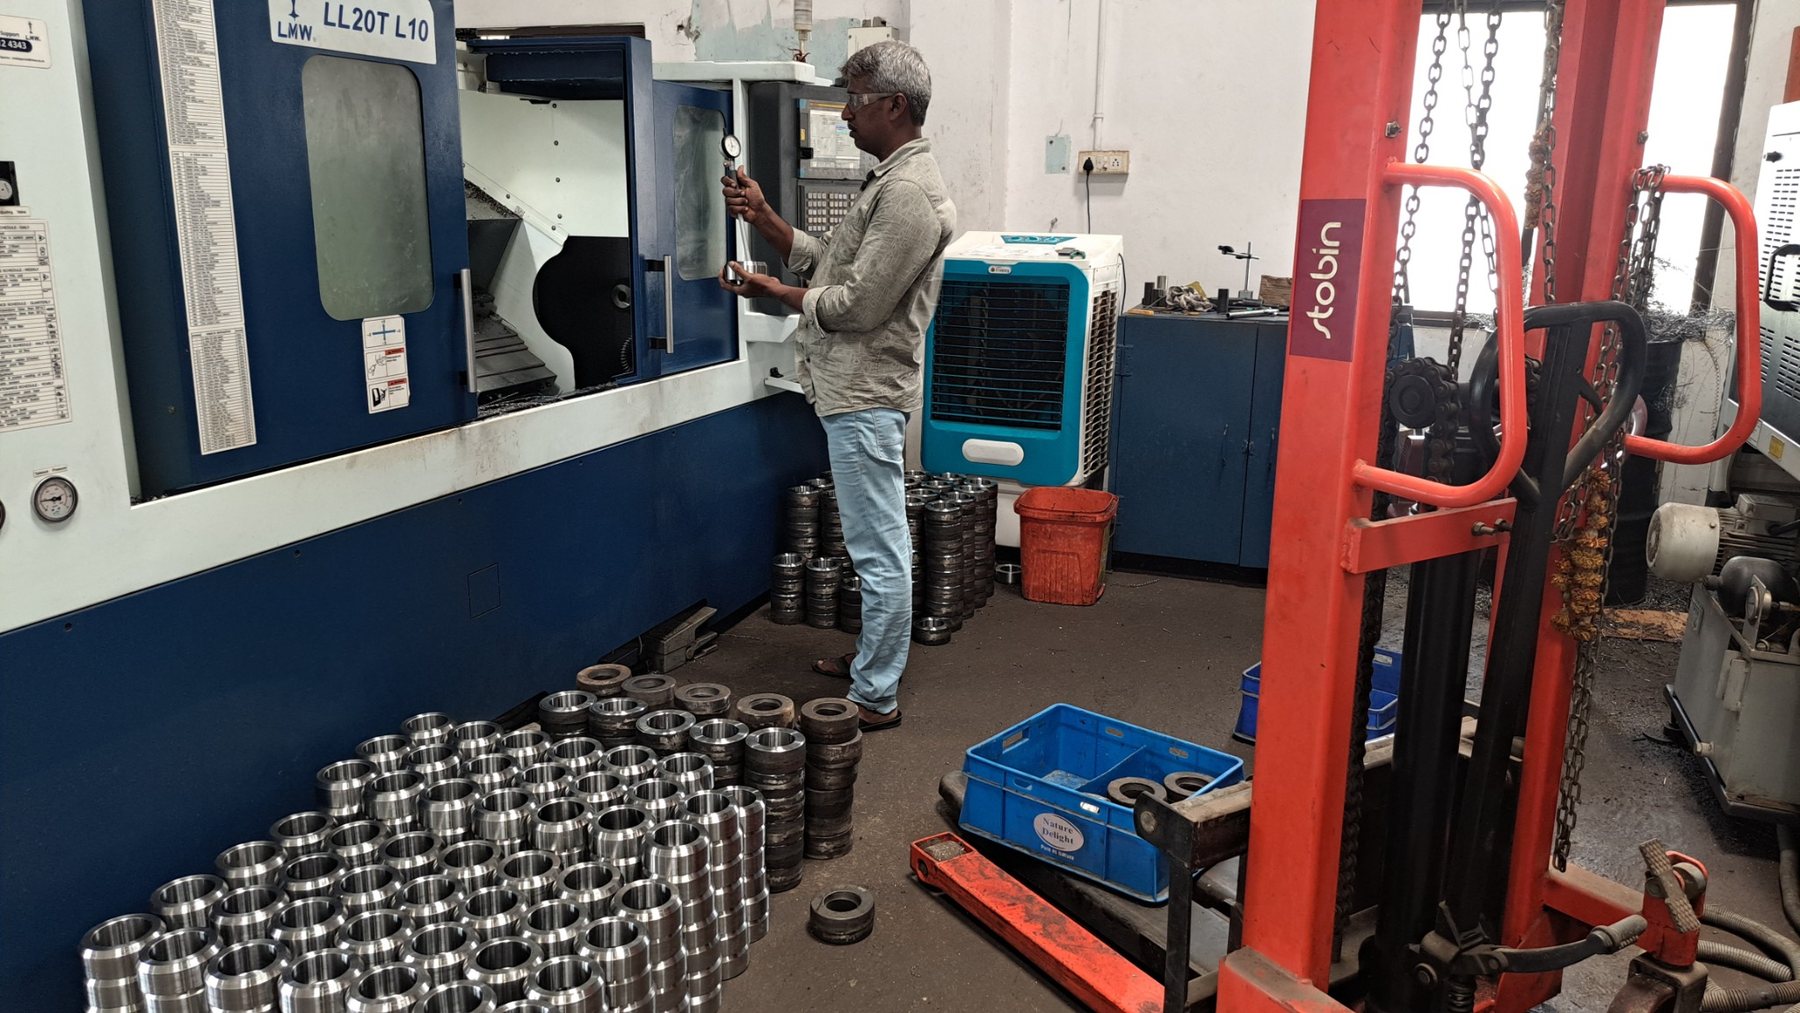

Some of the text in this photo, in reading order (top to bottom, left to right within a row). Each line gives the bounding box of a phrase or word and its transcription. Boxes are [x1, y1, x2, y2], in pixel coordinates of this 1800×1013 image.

[277, 21, 313, 42] LMW
[323, 2, 429, 42] LL20T L10
[7, 40, 27, 50] 4343
[1306, 222, 1342, 340] stobin
[1043, 817, 1074, 835] Nature
[1042, 827, 1074, 845] Delight
